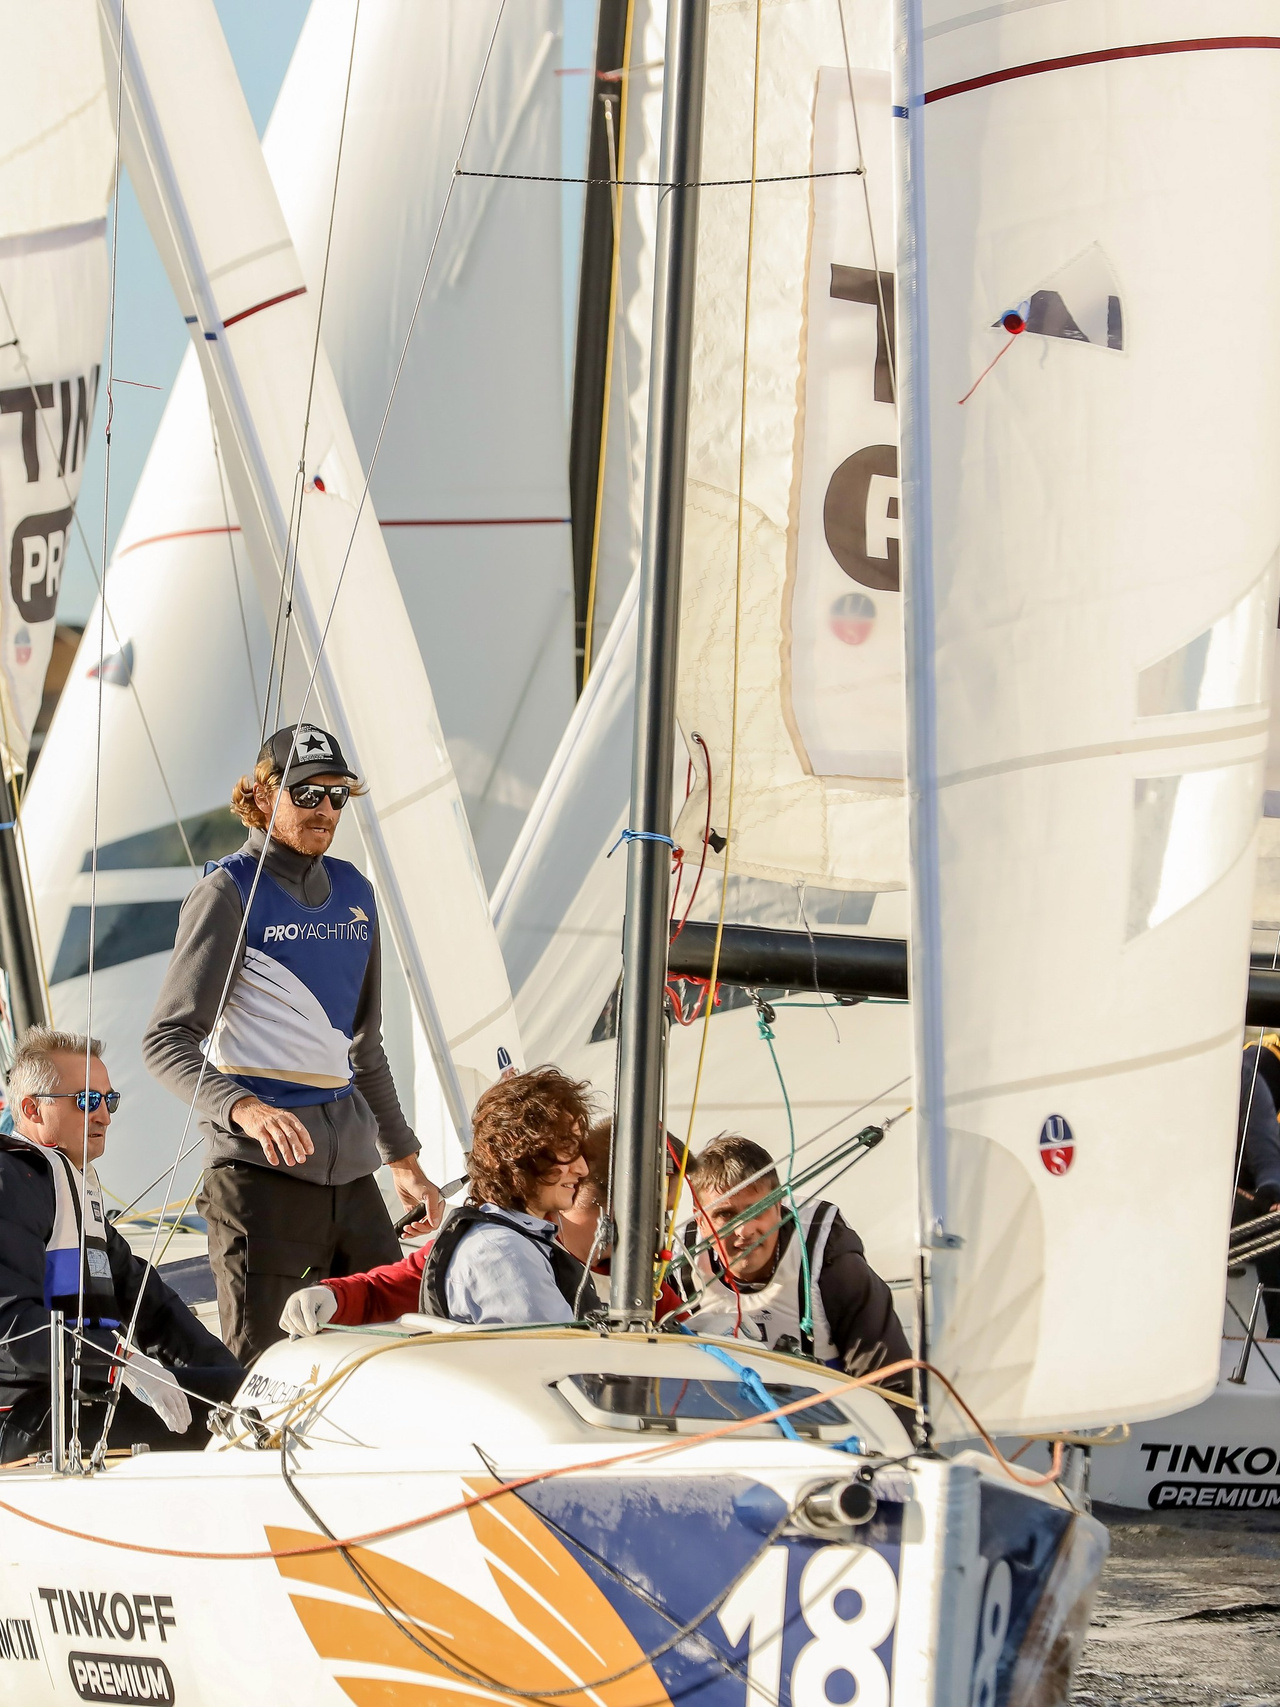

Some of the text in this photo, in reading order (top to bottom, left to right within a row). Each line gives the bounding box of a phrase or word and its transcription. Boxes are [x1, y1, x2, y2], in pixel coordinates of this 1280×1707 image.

[263, 923, 368, 943] PROYACHTING
[1140, 1442, 1280, 1476] TINKO
[38, 1587, 177, 1643] TINKOFF
[717, 1543, 899, 1707] 18
[72, 1659, 170, 1700] PREMIUM
